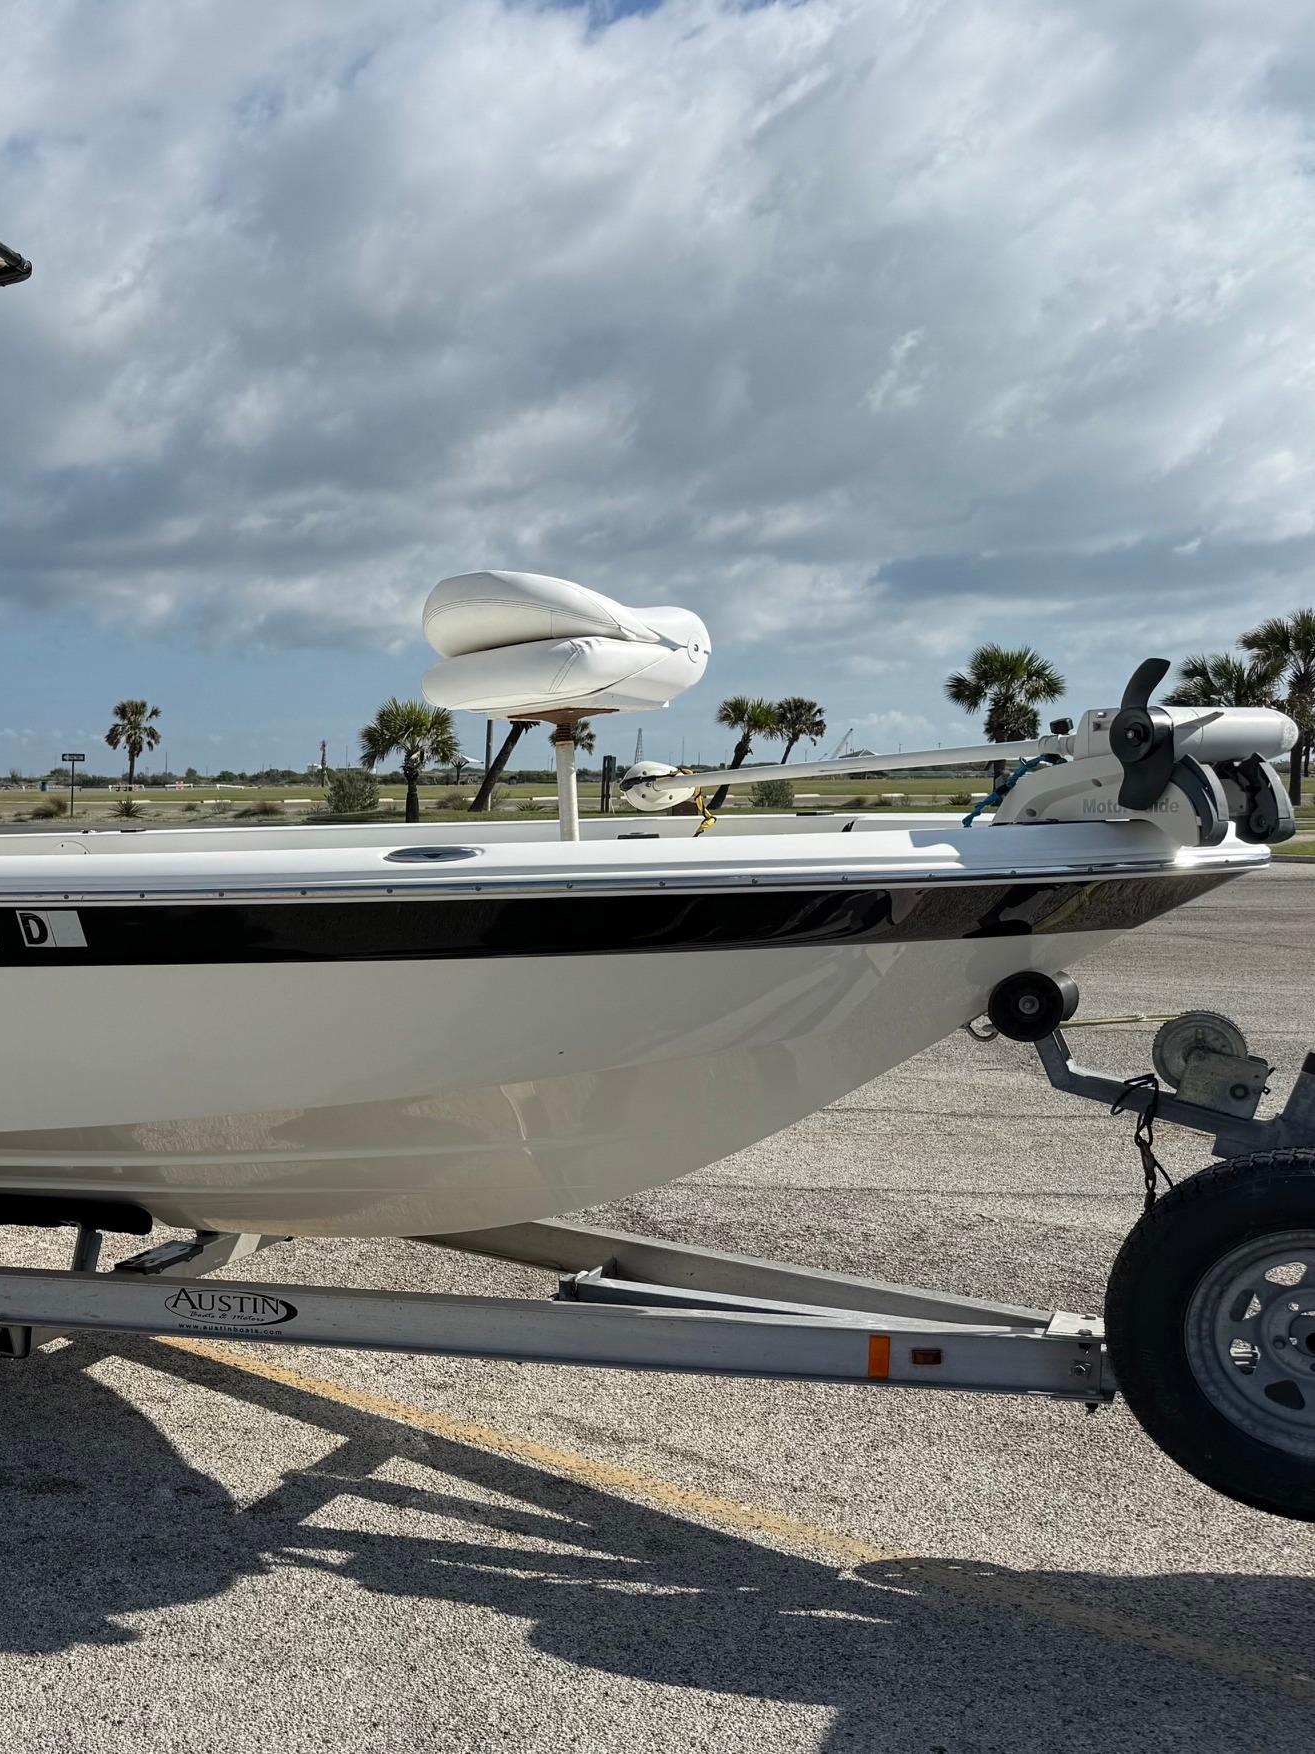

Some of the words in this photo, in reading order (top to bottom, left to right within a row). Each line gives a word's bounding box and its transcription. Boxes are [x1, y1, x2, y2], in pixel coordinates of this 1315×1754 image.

[1083, 799, 1180, 814] Motoide
[20, 912, 49, 946] D
[171, 1287, 281, 1316] AUSTIN
[178, 1322, 283, 1336] www.austinboats.com
